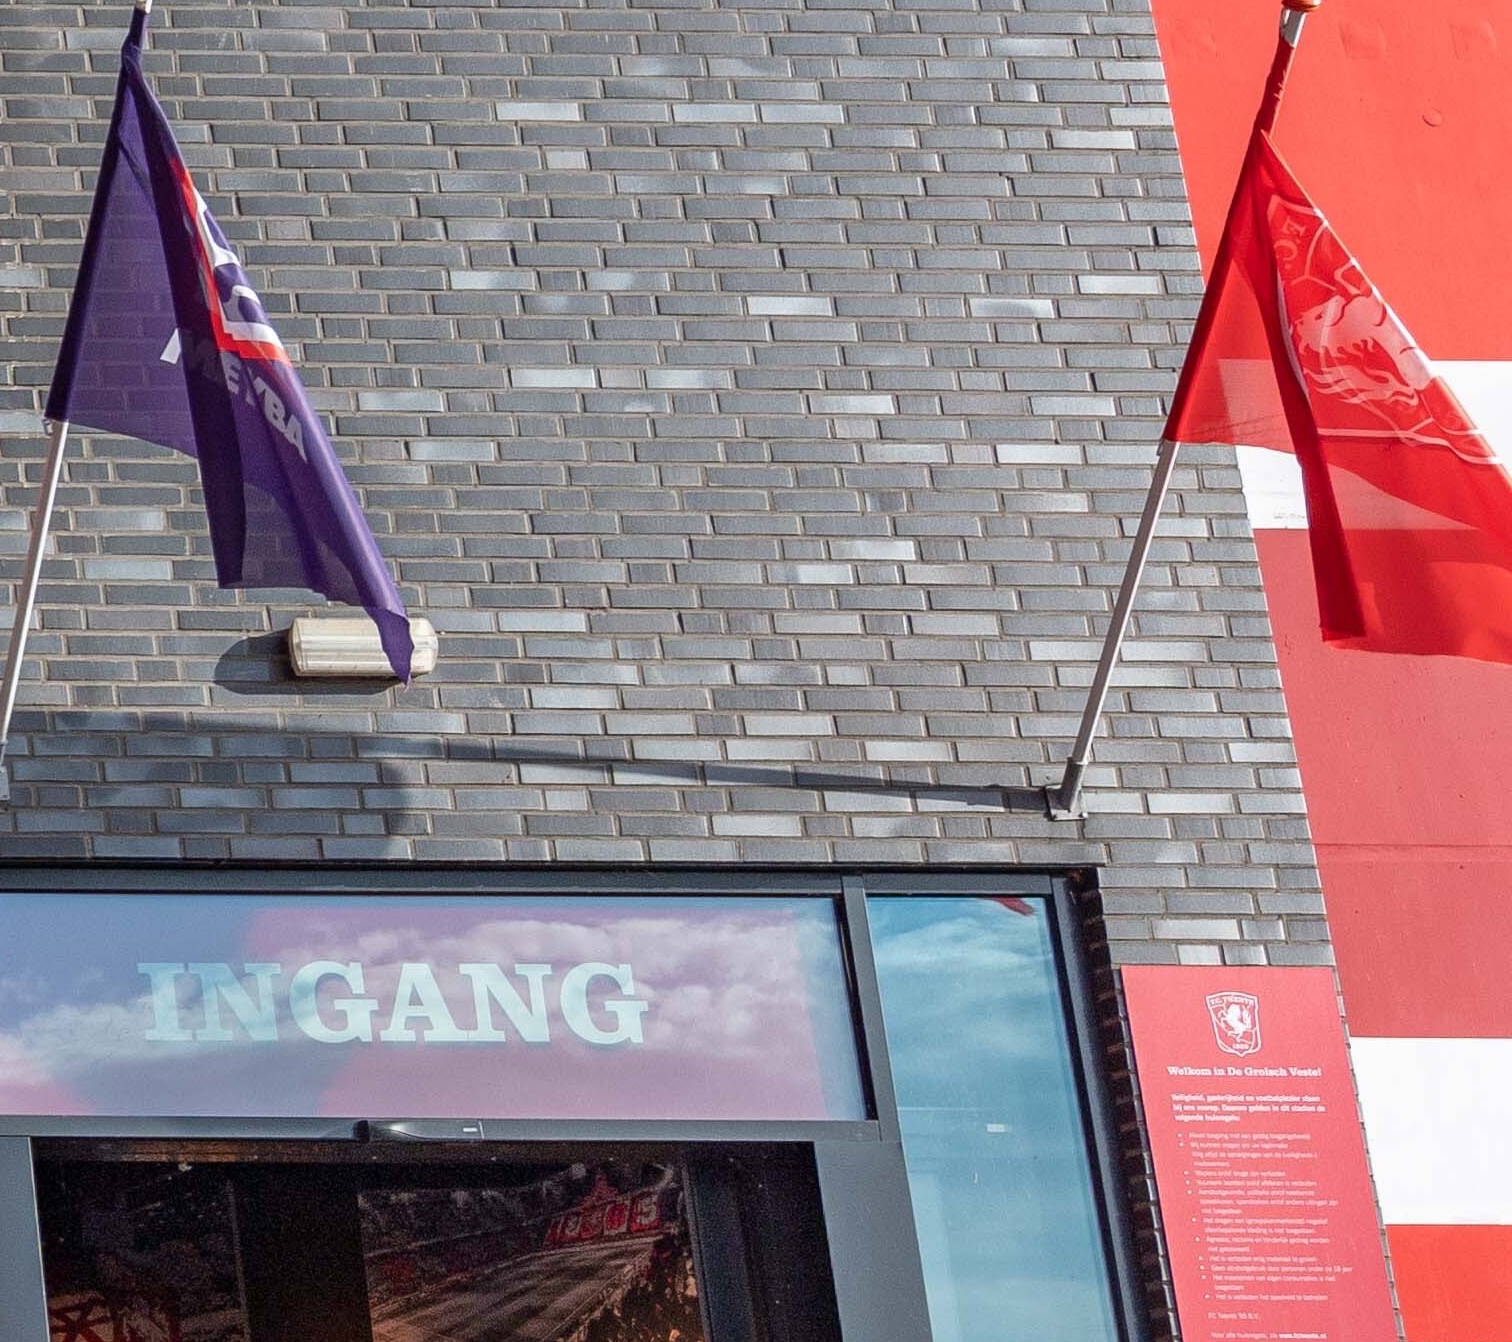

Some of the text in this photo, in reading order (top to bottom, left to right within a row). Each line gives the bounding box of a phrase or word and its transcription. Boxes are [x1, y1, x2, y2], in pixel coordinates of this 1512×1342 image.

[136, 960, 650, 1045] INGANG
[1166, 1066, 1212, 1076] Welkom
[1214, 1066, 1225, 1076] in
[1227, 1067, 1241, 1076] De
